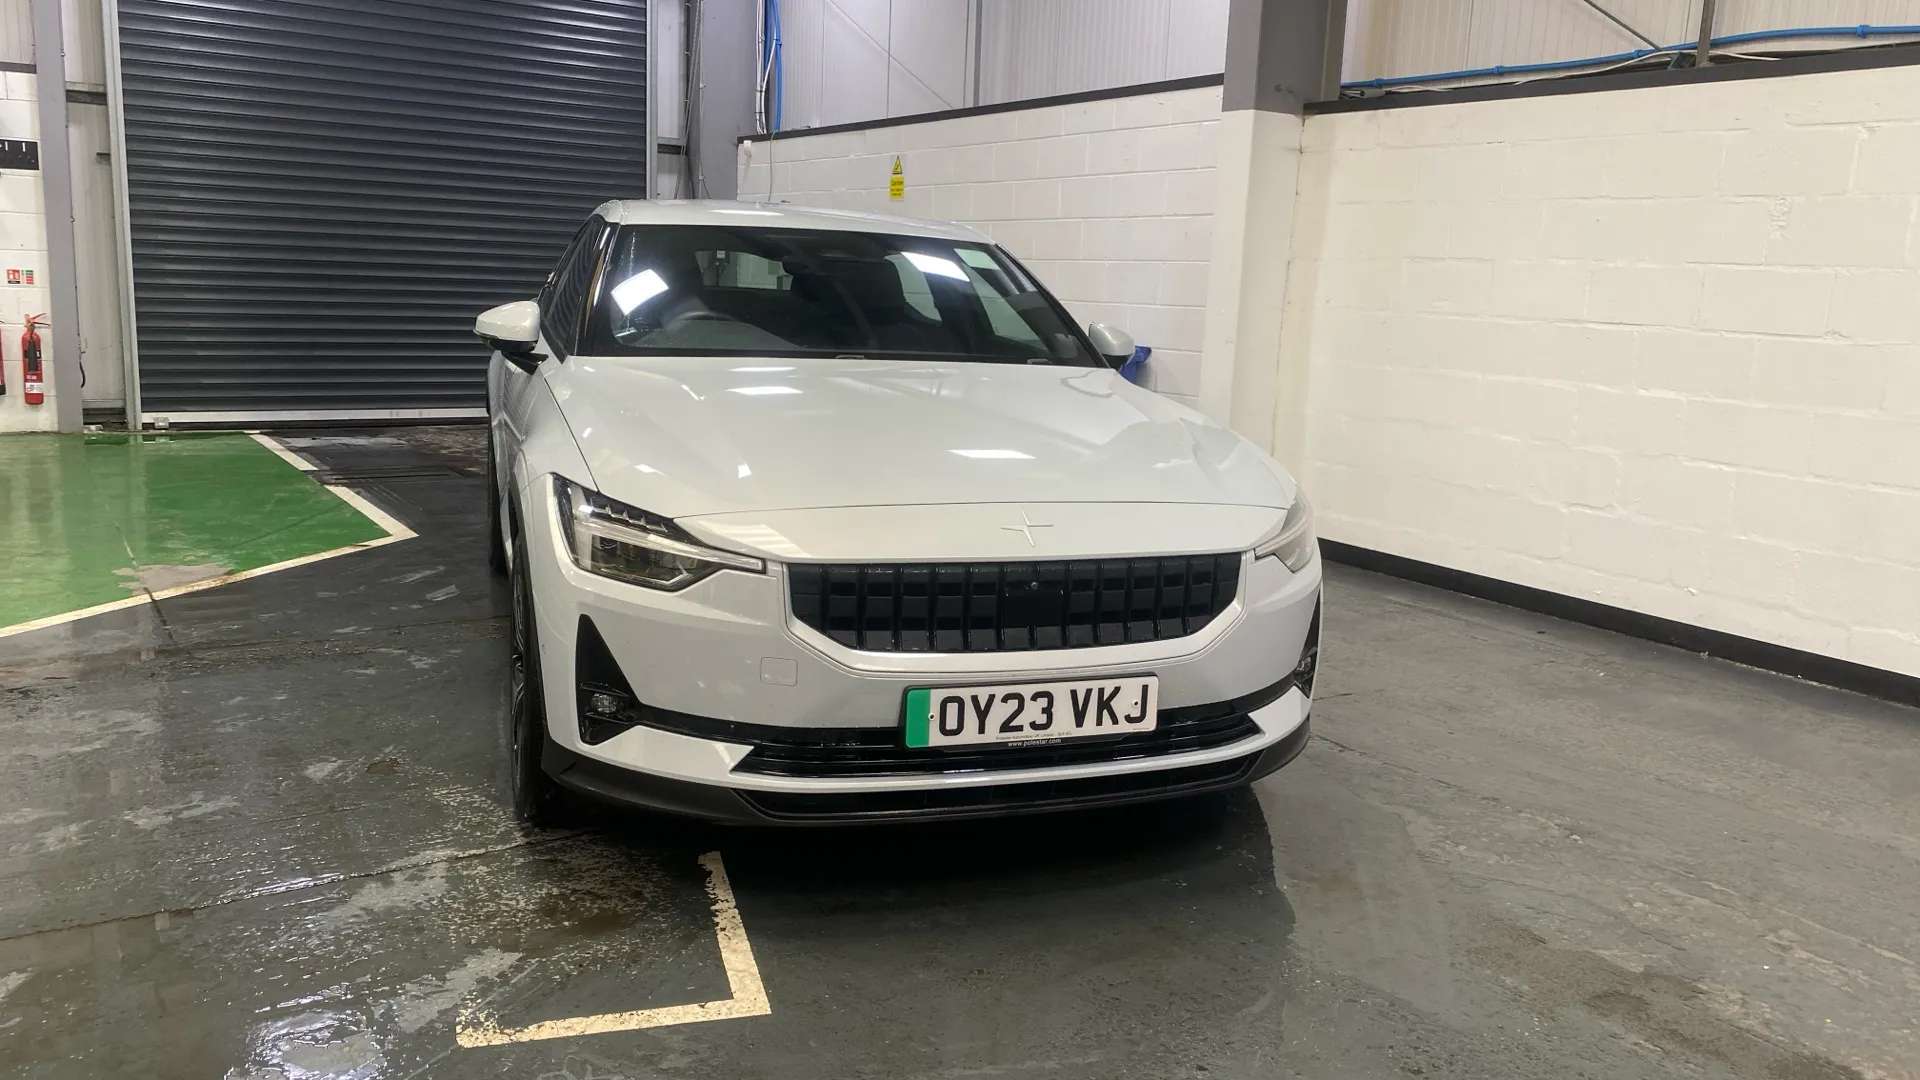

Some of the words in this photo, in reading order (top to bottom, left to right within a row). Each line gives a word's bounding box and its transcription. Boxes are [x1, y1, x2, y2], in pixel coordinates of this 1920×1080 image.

[939, 691, 1054, 736] OY23
[1070, 684, 1149, 728] VKJ
[1008, 738, 1062, 747] www.polestar.com
